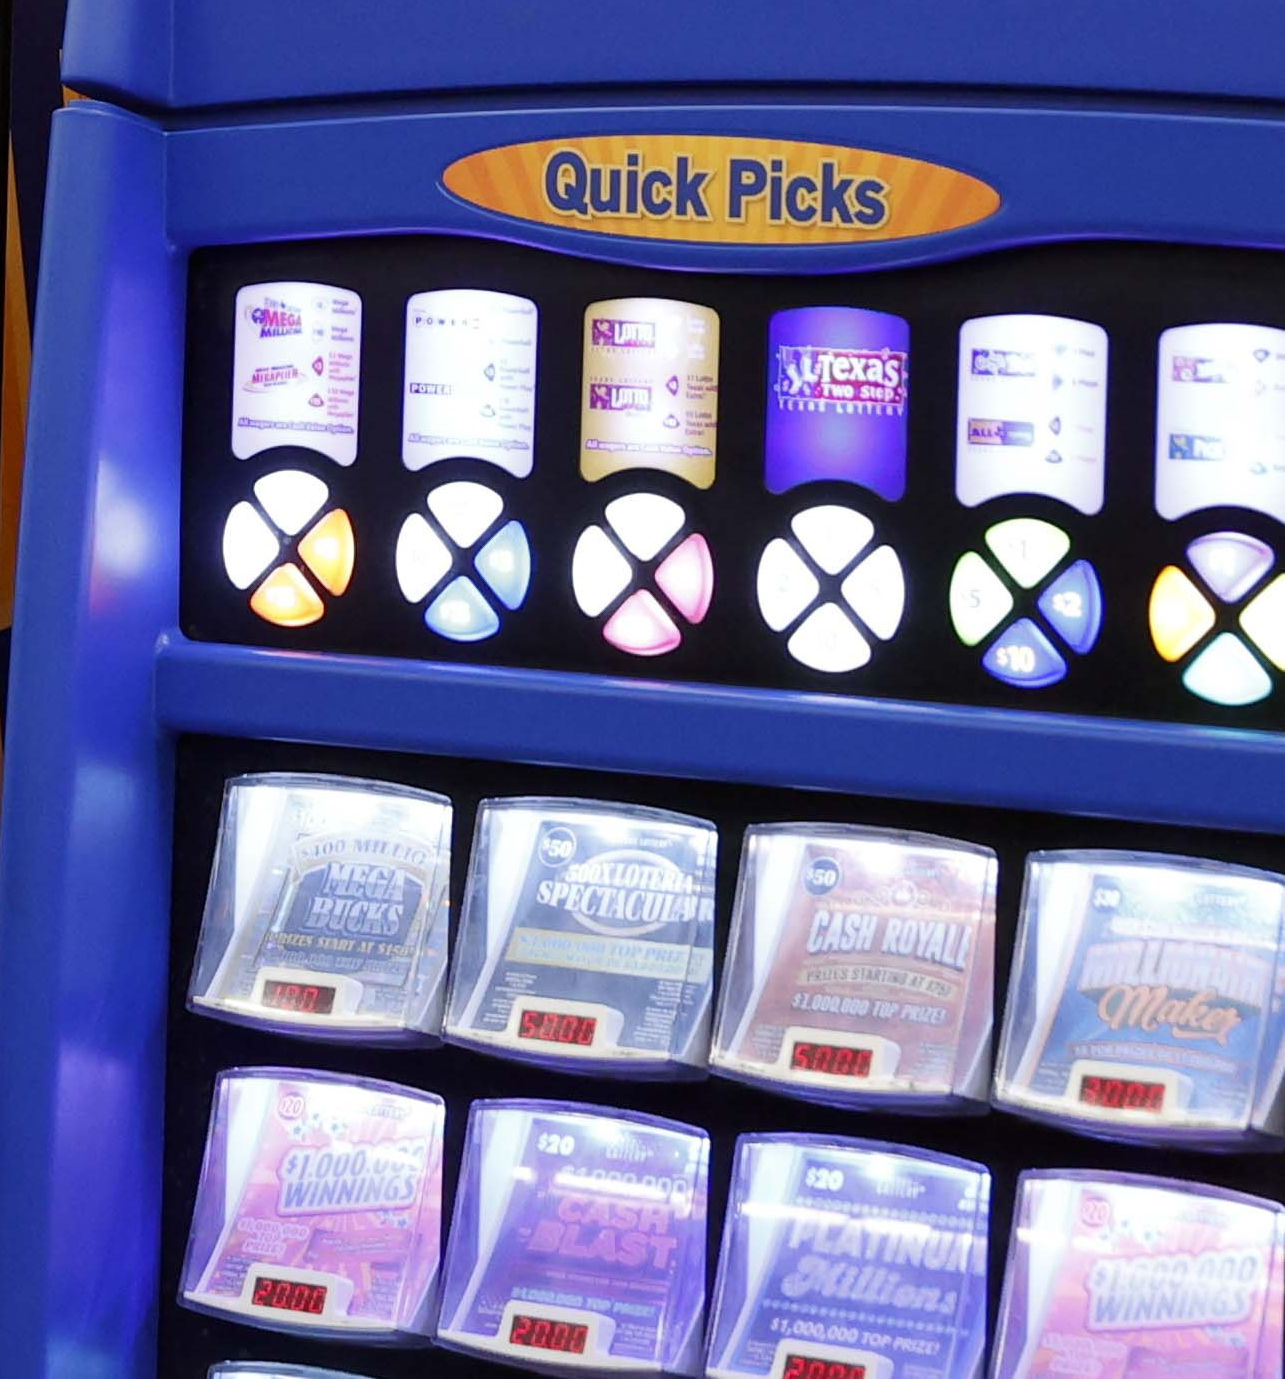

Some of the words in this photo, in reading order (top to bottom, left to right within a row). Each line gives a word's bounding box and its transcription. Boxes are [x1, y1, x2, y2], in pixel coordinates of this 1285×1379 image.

[545, 152, 709, 215] Quick
[731, 159, 886, 223] Picks
[817, 354, 900, 388] Texas
[995, 645, 1036, 672] $10
[542, 837, 573, 859] $50
[323, 861, 406, 902] MEGA
[806, 868, 837, 887] $50
[309, 895, 404, 936] BUCKS
[536, 879, 716, 923] SPECTACULAR
[807, 909, 878, 955] CASH
[852, 966, 906, 984] STARTING
[909, 975, 925, 988] AT
[872, 1001, 899, 1019] TOP
[1097, 984, 1242, 1049] Maker
[537, 1132, 575, 1156] $20
[284, 1175, 415, 1209] WINNINGS
[805, 1166, 845, 1191] $20
[558, 1197, 670, 1235] CASH
[527, 1218, 678, 1269] BLAST
[781, 1254, 958, 1315] Millions
[1094, 1285, 1247, 1323] WINNINGS
[770, 1317, 859, 1343] $1,000,000
[861, 1331, 892, 1350] TOP
